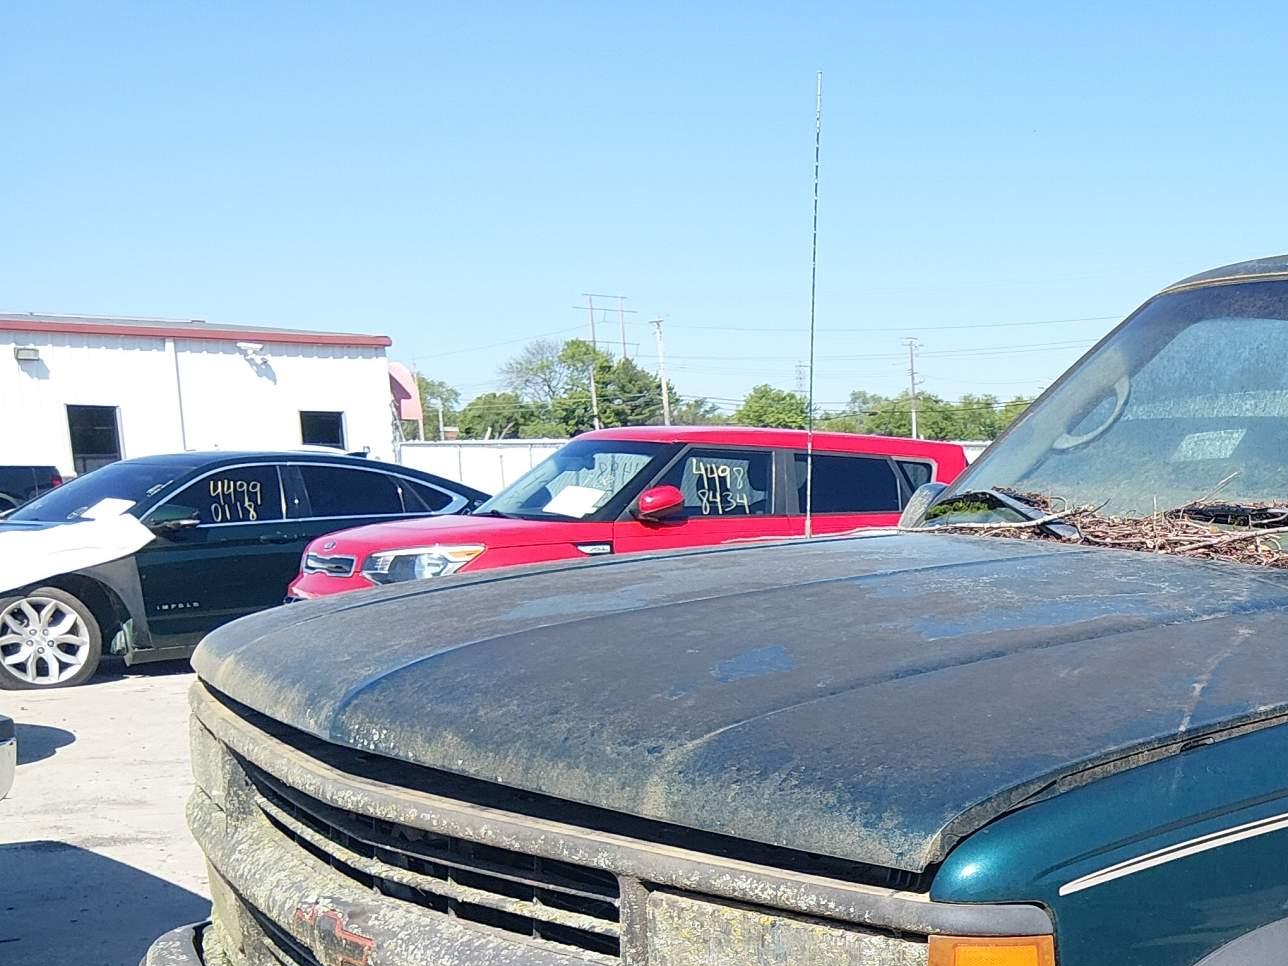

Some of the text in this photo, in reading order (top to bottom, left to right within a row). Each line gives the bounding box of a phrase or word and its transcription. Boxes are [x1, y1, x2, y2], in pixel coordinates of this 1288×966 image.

[692, 458, 744, 490] 4498
[209, 479, 262, 505] 4499
[697, 488, 750, 515] 8434
[211, 501, 257, 522] 0118
